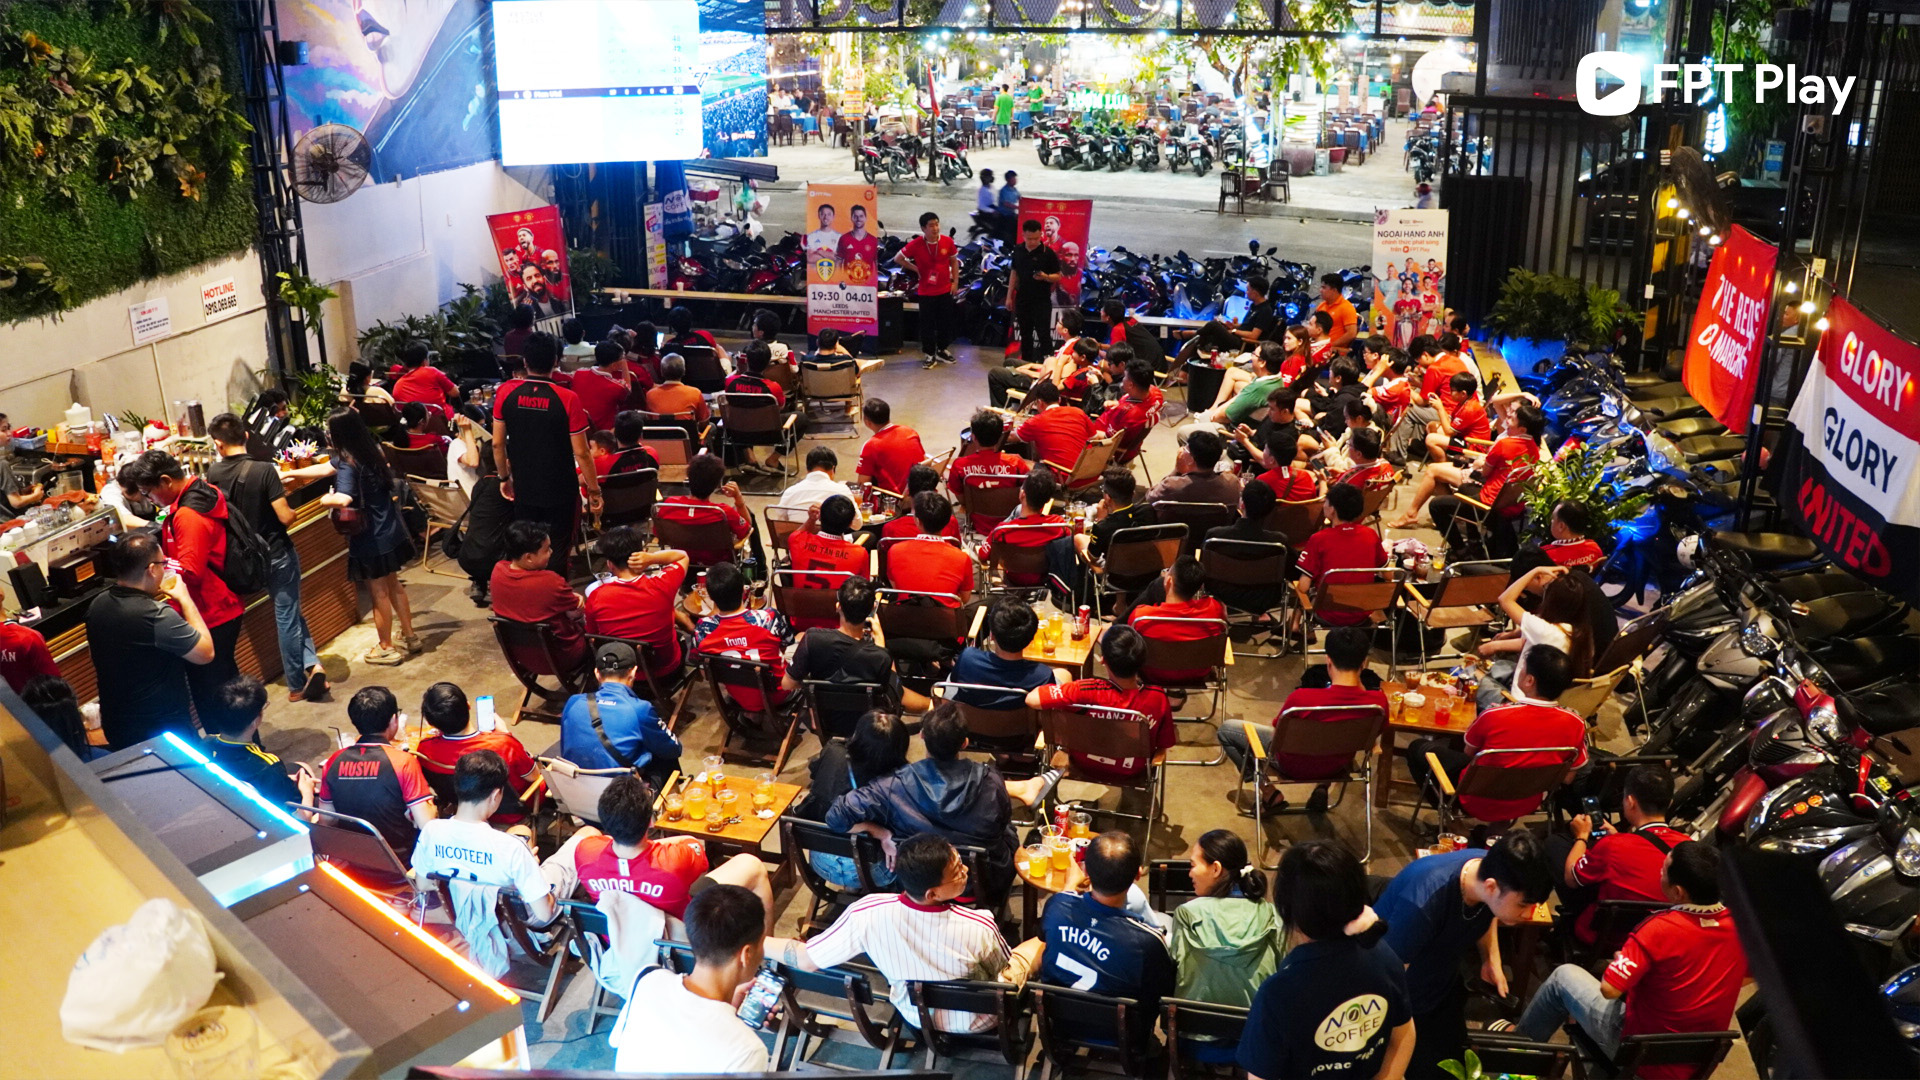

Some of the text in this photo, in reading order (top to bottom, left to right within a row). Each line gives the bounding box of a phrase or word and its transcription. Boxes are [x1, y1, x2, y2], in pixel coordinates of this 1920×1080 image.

[203, 281, 235, 300] HOTLINE
[812, 291, 873, 303] 19:30 04.01
[1840, 330, 1911, 413] GLORY
[1823, 407, 1898, 494] GLORY
[724, 636, 748, 647] Trung
[338, 760, 380, 777] MUSVN
[434, 844, 493, 865] NICOTEEN
[588, 877, 664, 897] RONALDO
[1058, 925, 1110, 961] THÔNG
[1055, 951, 1098, 992] 7
[1324, 1016, 1381, 1048] COFFEE
